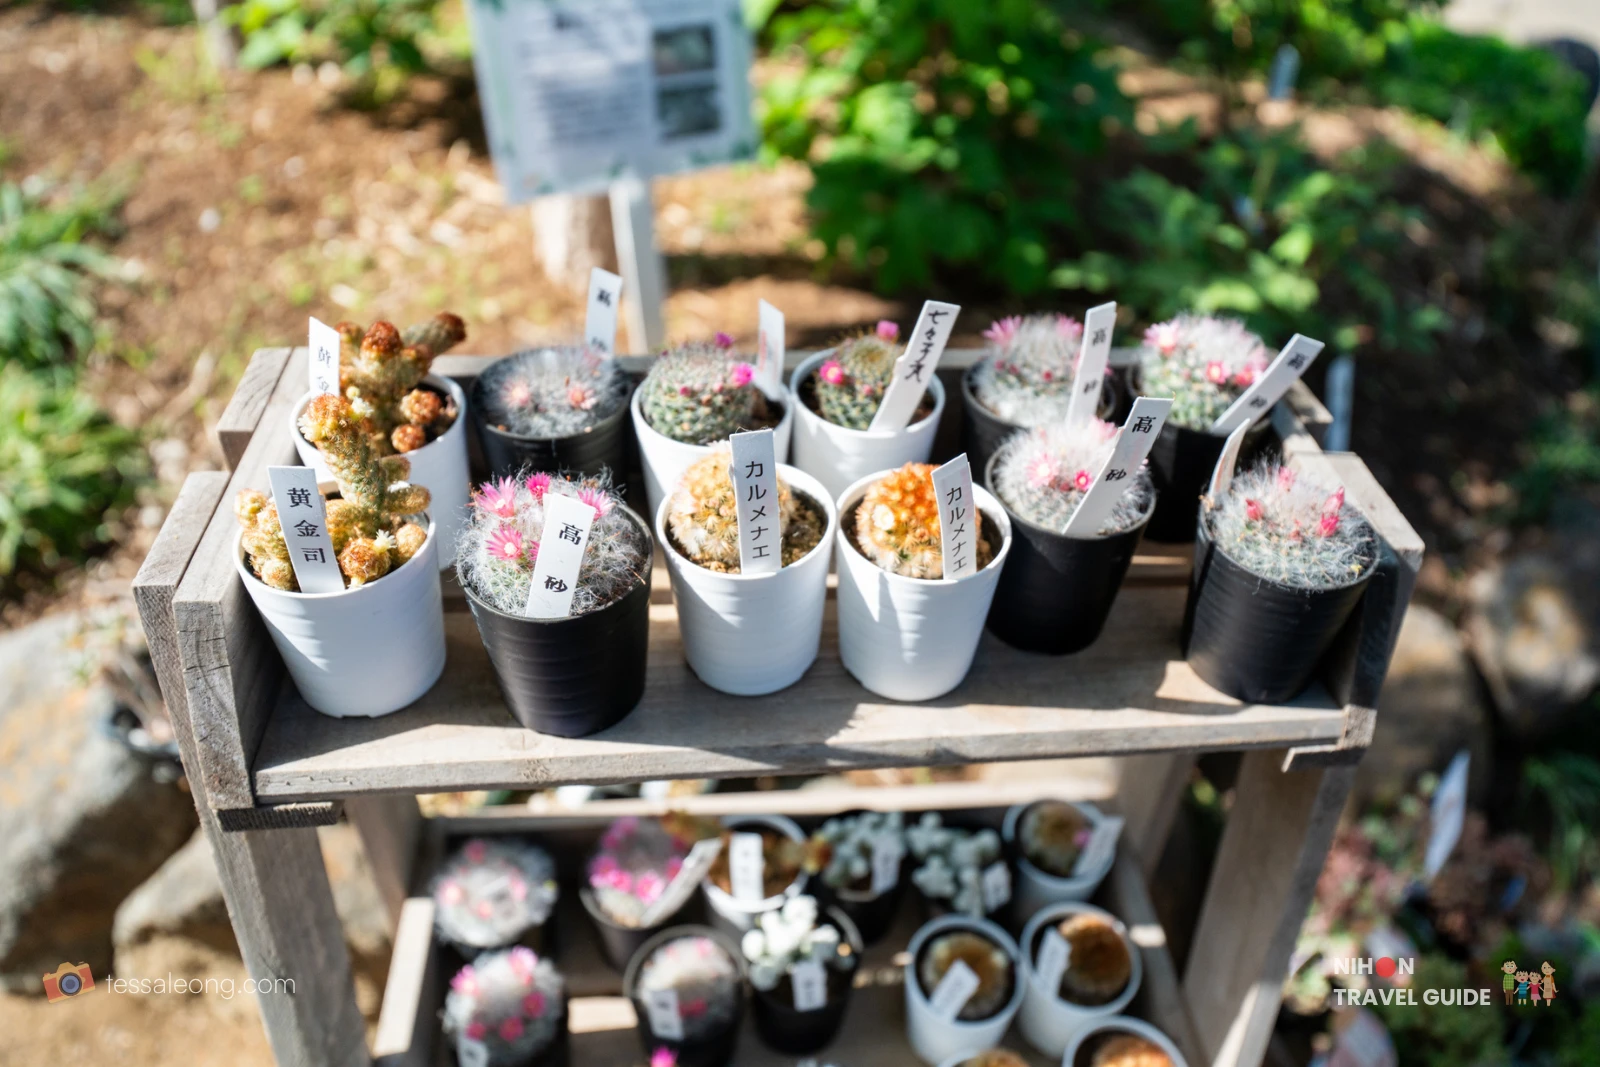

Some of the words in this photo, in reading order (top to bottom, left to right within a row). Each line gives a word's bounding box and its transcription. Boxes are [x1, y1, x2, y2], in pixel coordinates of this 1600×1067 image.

[1104, 416, 1157, 482] 高砂
[286, 487, 327, 564] 黄金司
[745, 460, 771, 559] カルメナエ
[946, 486, 968, 573] カルメナエ
[543, 521, 585, 593] 高砂
